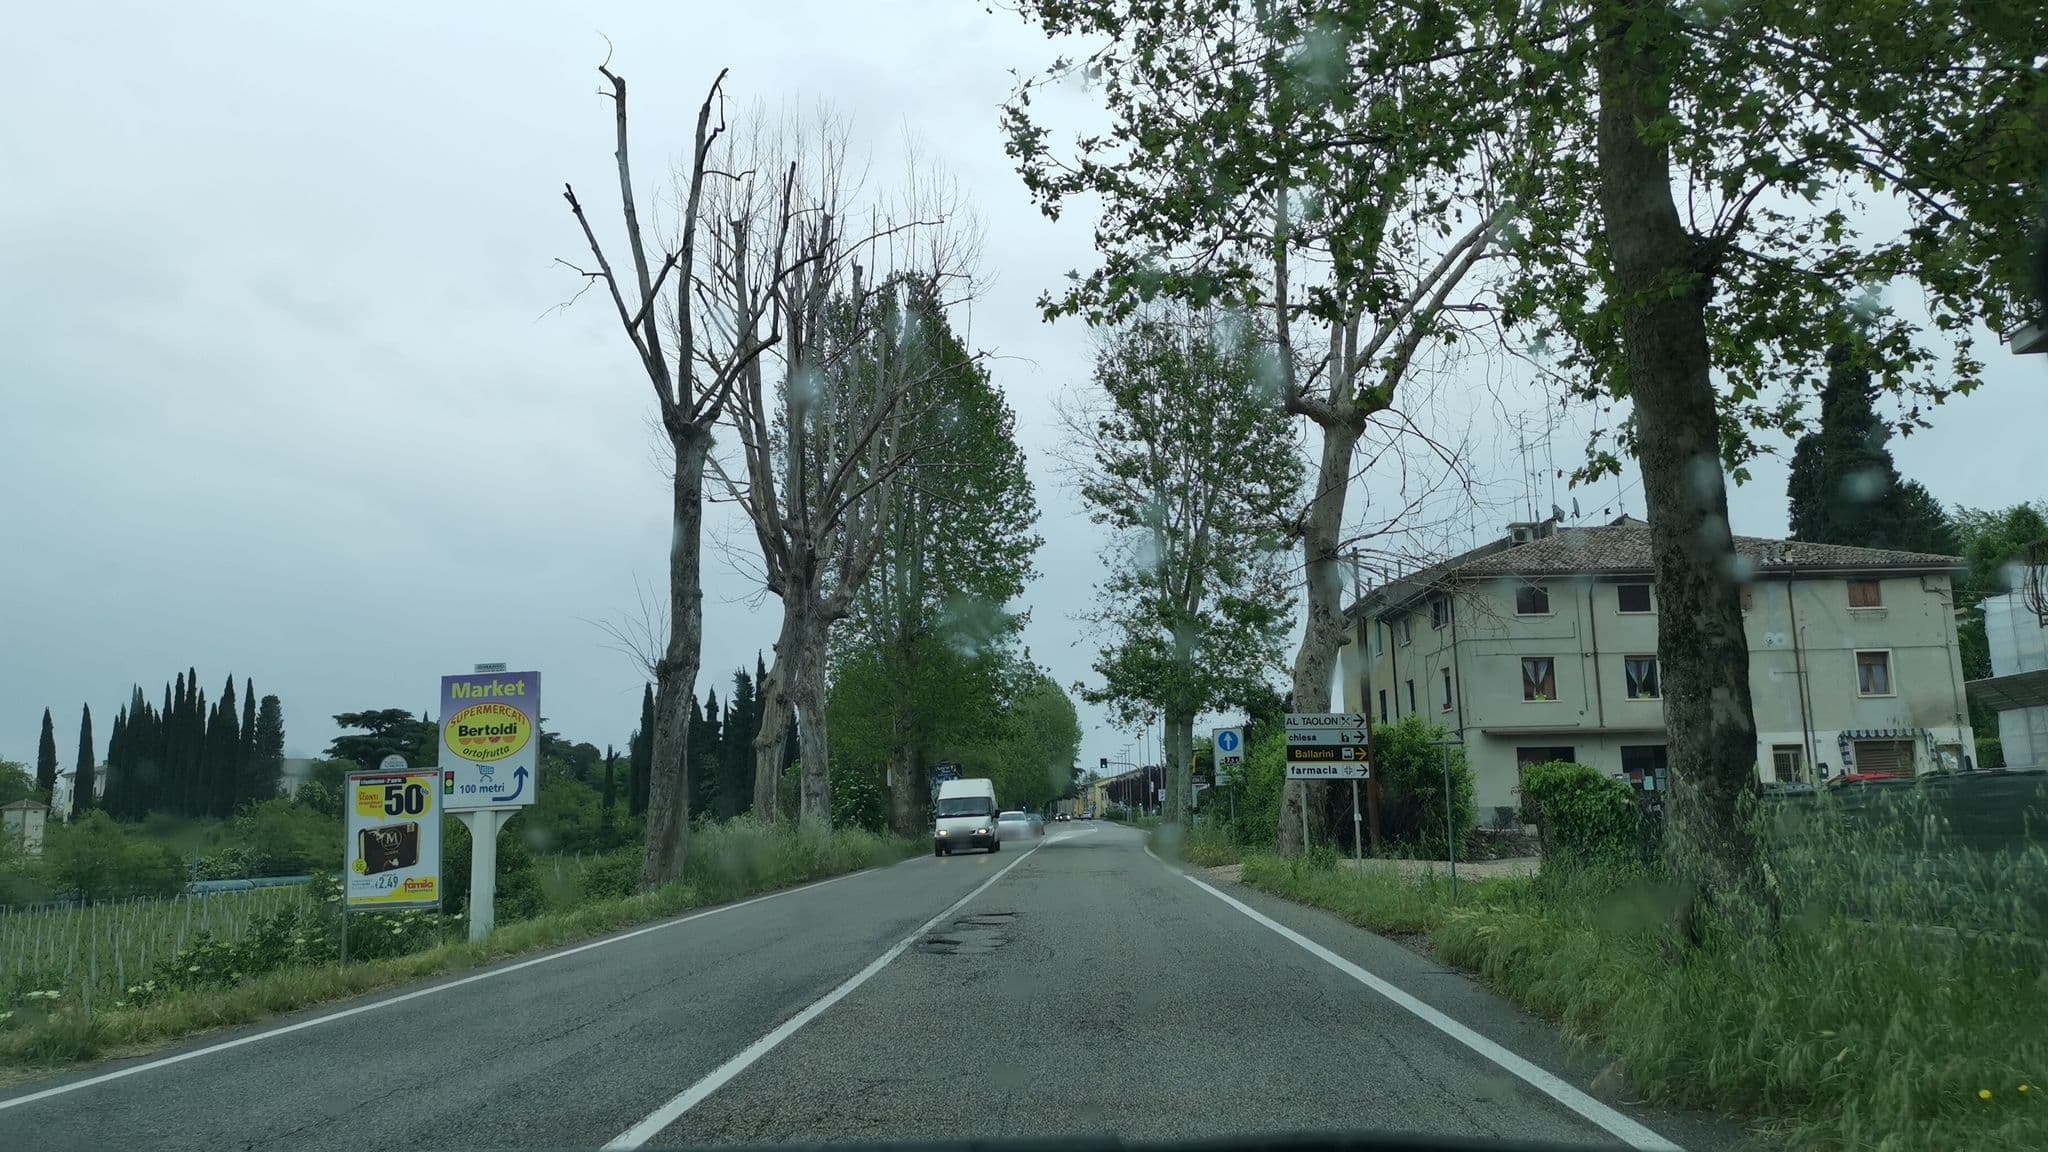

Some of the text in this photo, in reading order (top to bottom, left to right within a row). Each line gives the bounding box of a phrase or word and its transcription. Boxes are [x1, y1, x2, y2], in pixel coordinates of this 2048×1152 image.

[451, 680, 525, 699] Market
[450, 704, 526, 728] SUPERMERCATI
[1286, 717, 1298, 726] AL
[458, 722, 518, 737] Bertoldi
[1288, 733, 1317, 742] chiesa
[462, 745, 511, 759] ortofrutta
[1295, 749, 1334, 759] Ballarini
[1291, 766, 1338, 775] farmacia
[459, 782, 505, 794] 100 metri
